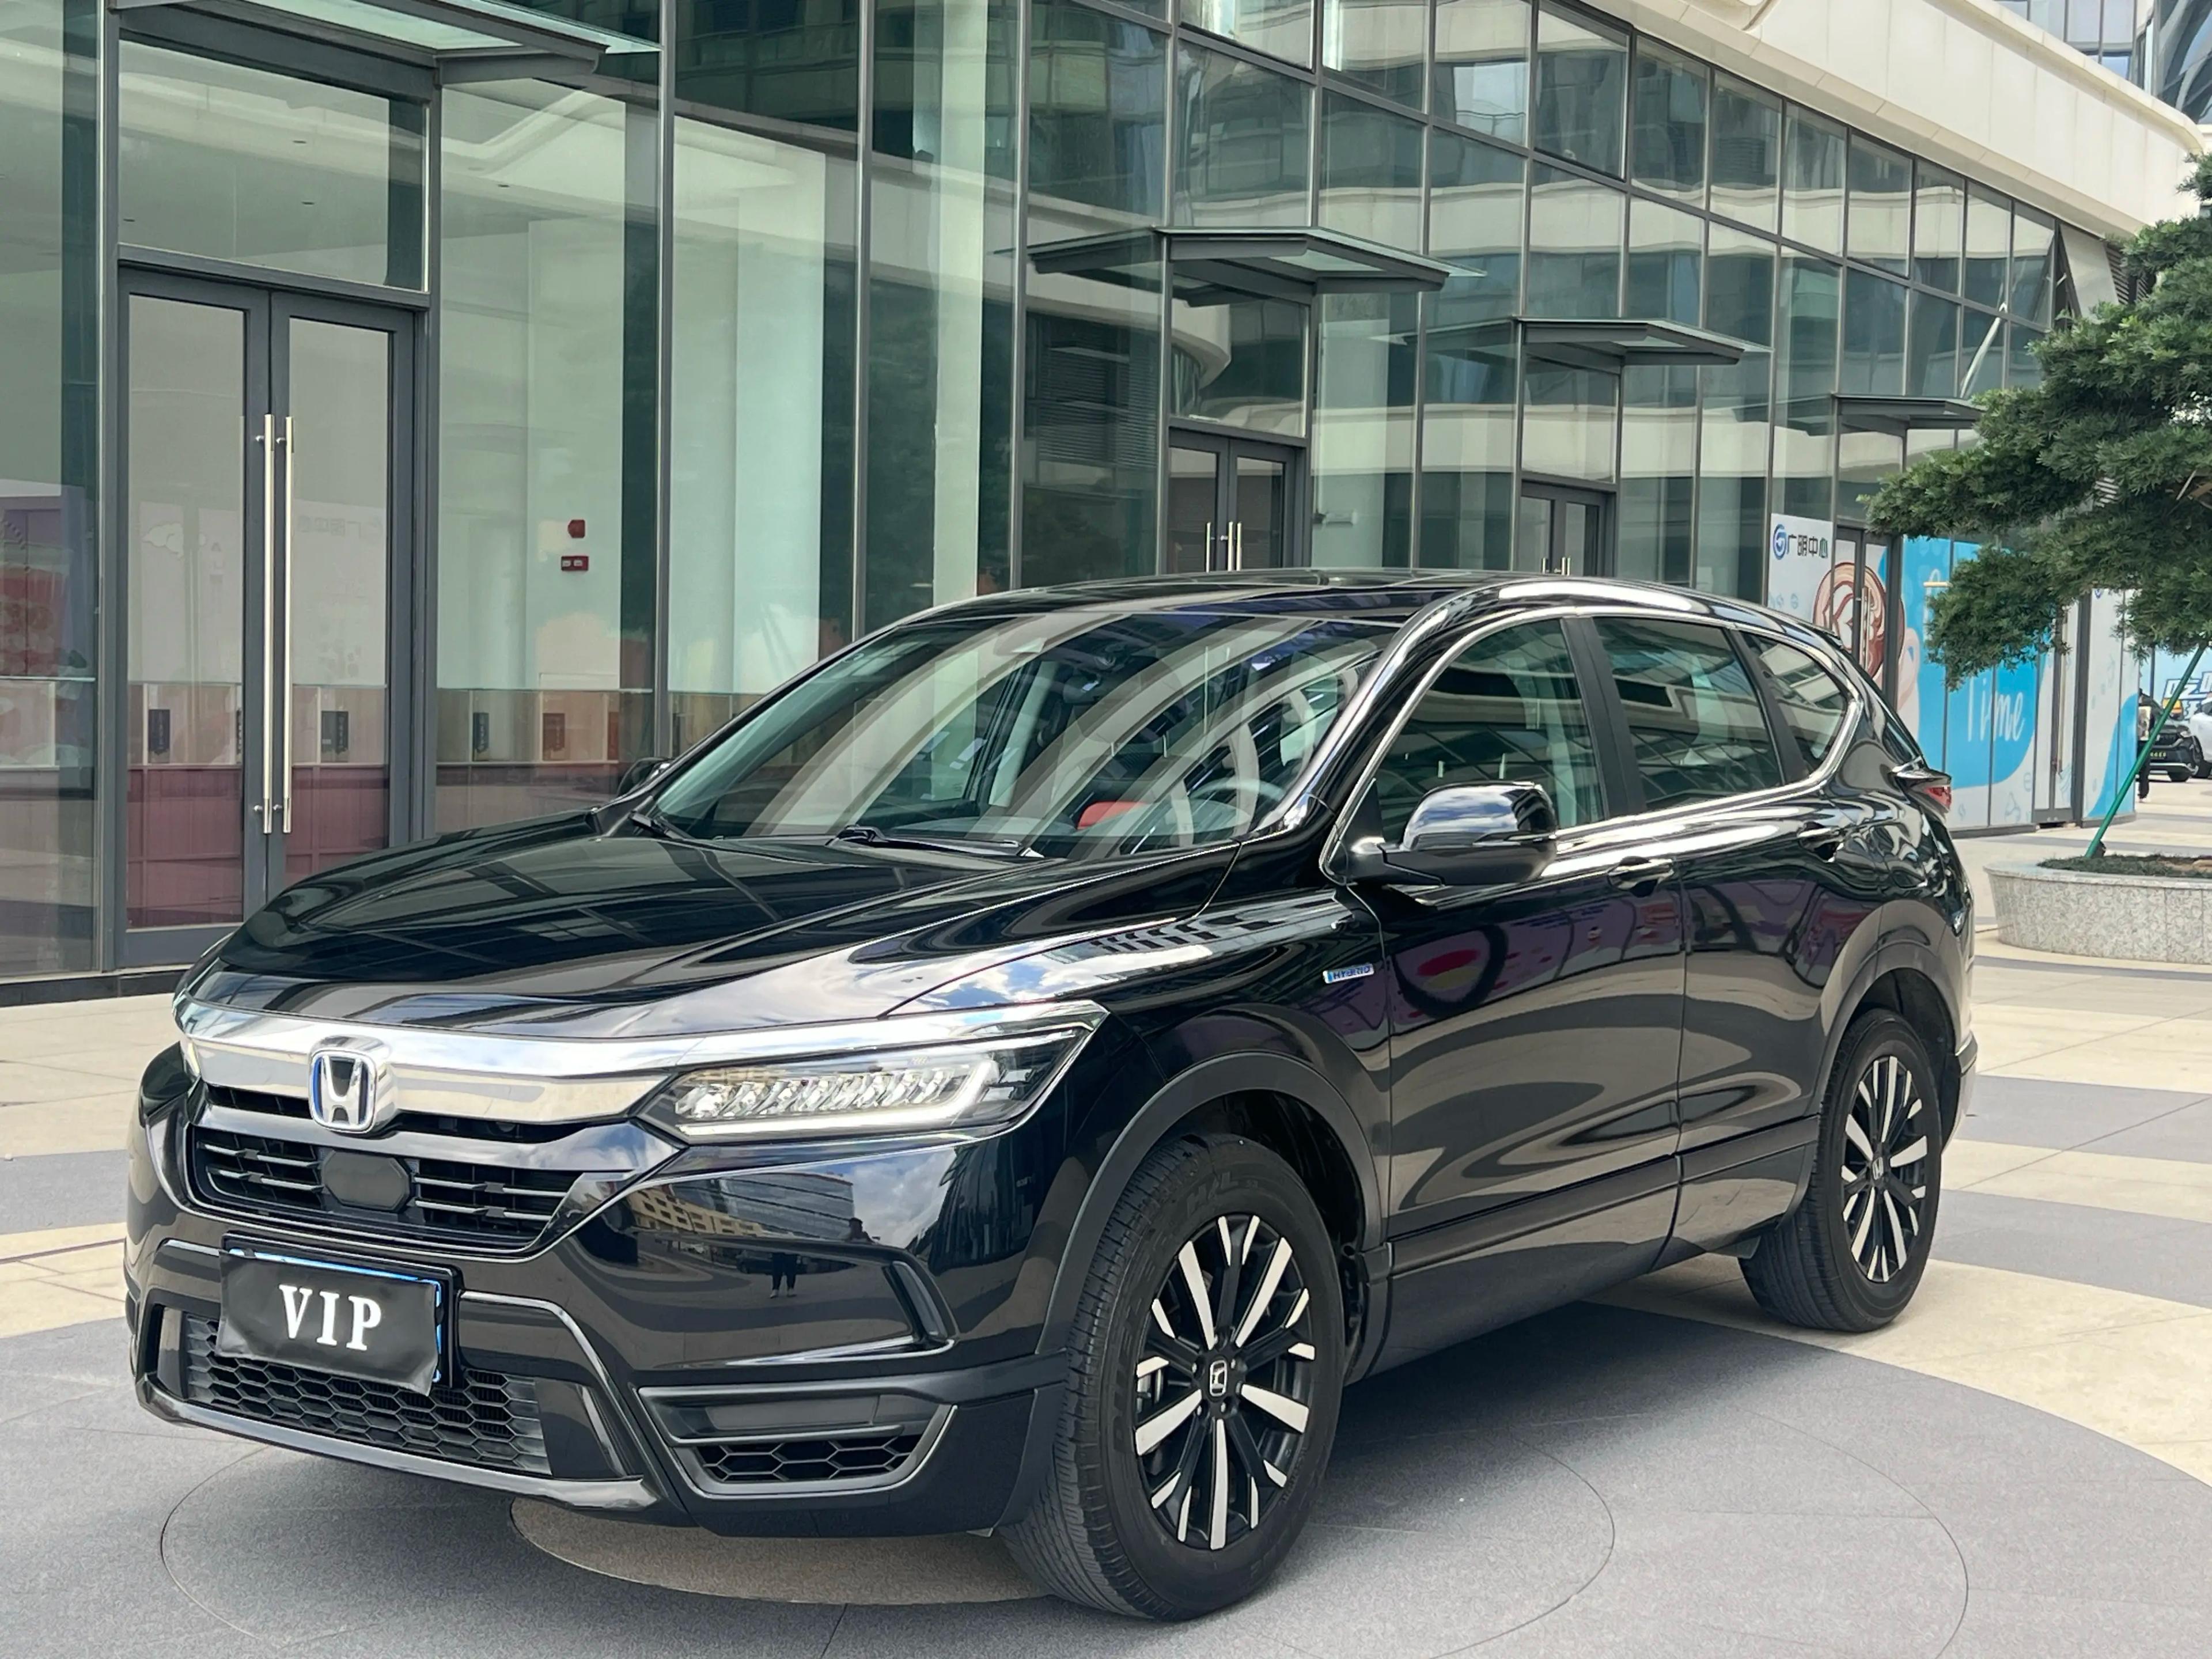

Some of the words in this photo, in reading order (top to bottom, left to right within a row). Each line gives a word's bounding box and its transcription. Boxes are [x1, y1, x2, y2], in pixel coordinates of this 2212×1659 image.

[1786, 534, 1828, 558] 广明中心
[1333, 965, 1371, 980] HYBRID
[279, 1284, 382, 1351] VIP
